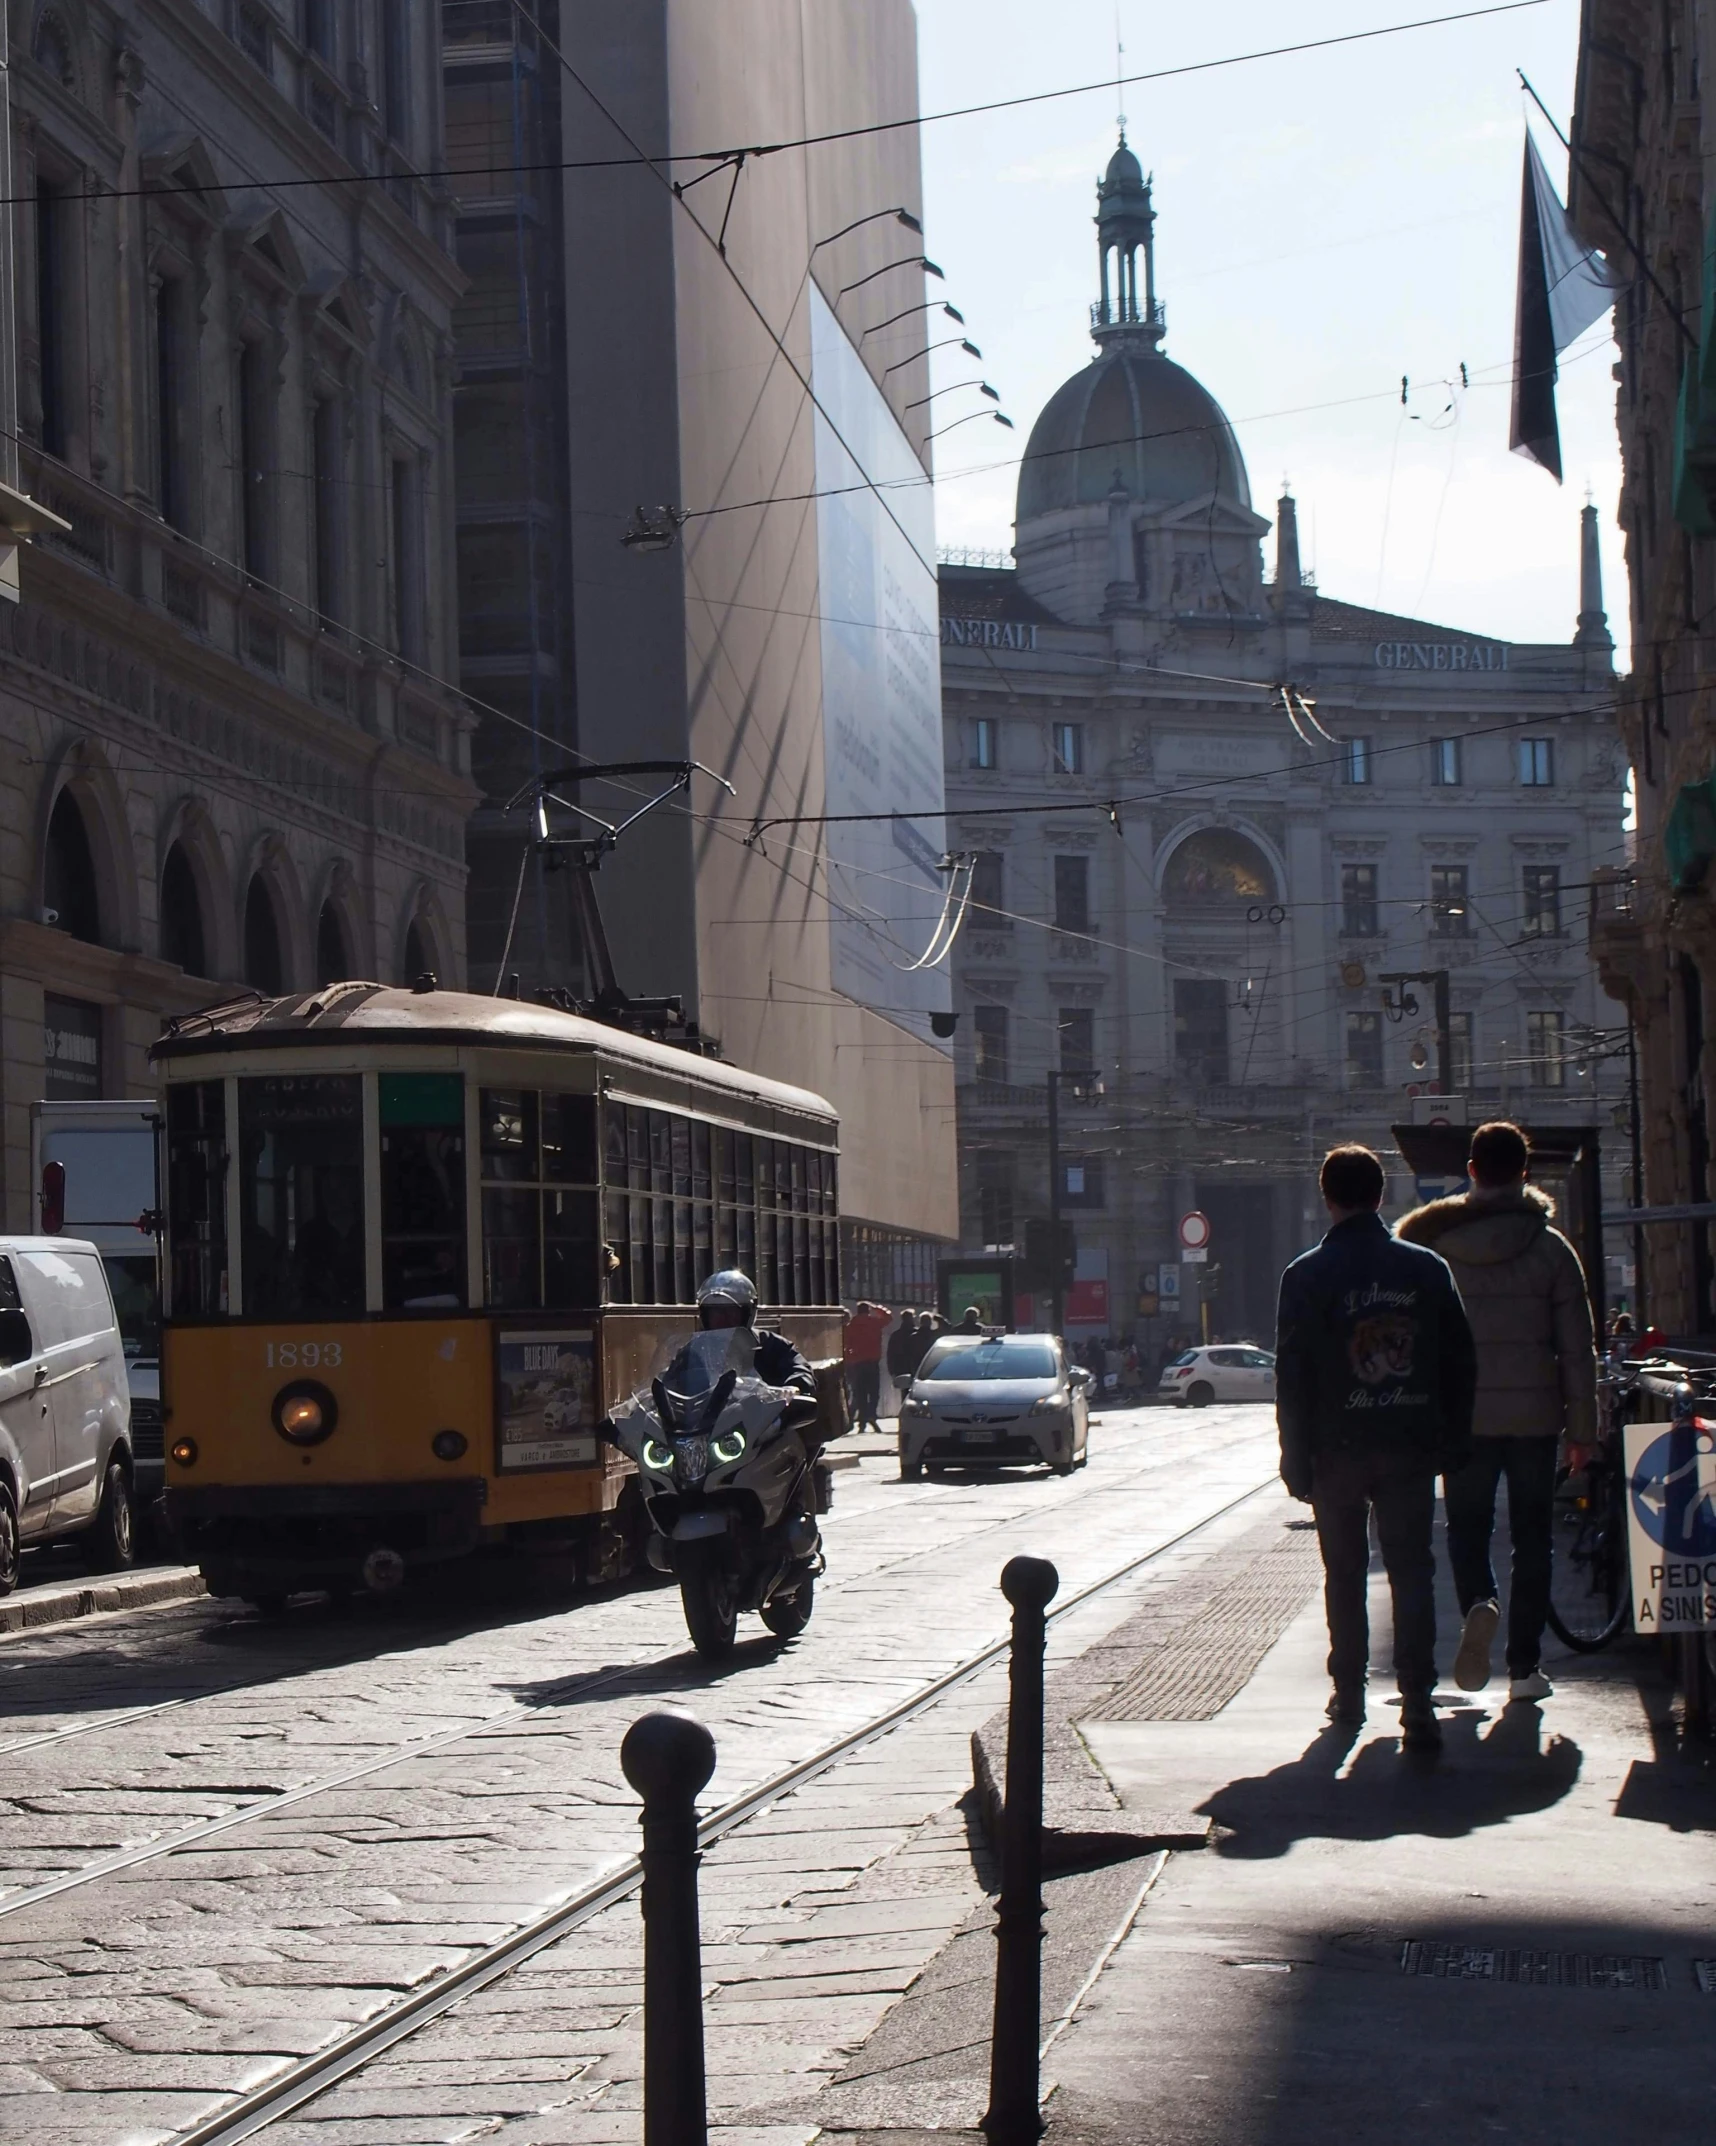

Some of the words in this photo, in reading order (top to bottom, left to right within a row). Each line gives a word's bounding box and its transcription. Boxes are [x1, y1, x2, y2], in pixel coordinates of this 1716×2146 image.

[1374, 642, 1511, 671] GENERALI
[266, 1342, 342, 1368] 1893
[524, 1345, 541, 1371] BLUE
[542, 1344, 559, 1371] DAYS
[1650, 1562, 1716, 1589] PEDO
[1639, 1598, 1655, 1622] A
[1661, 1595, 1716, 1622] SINIS
